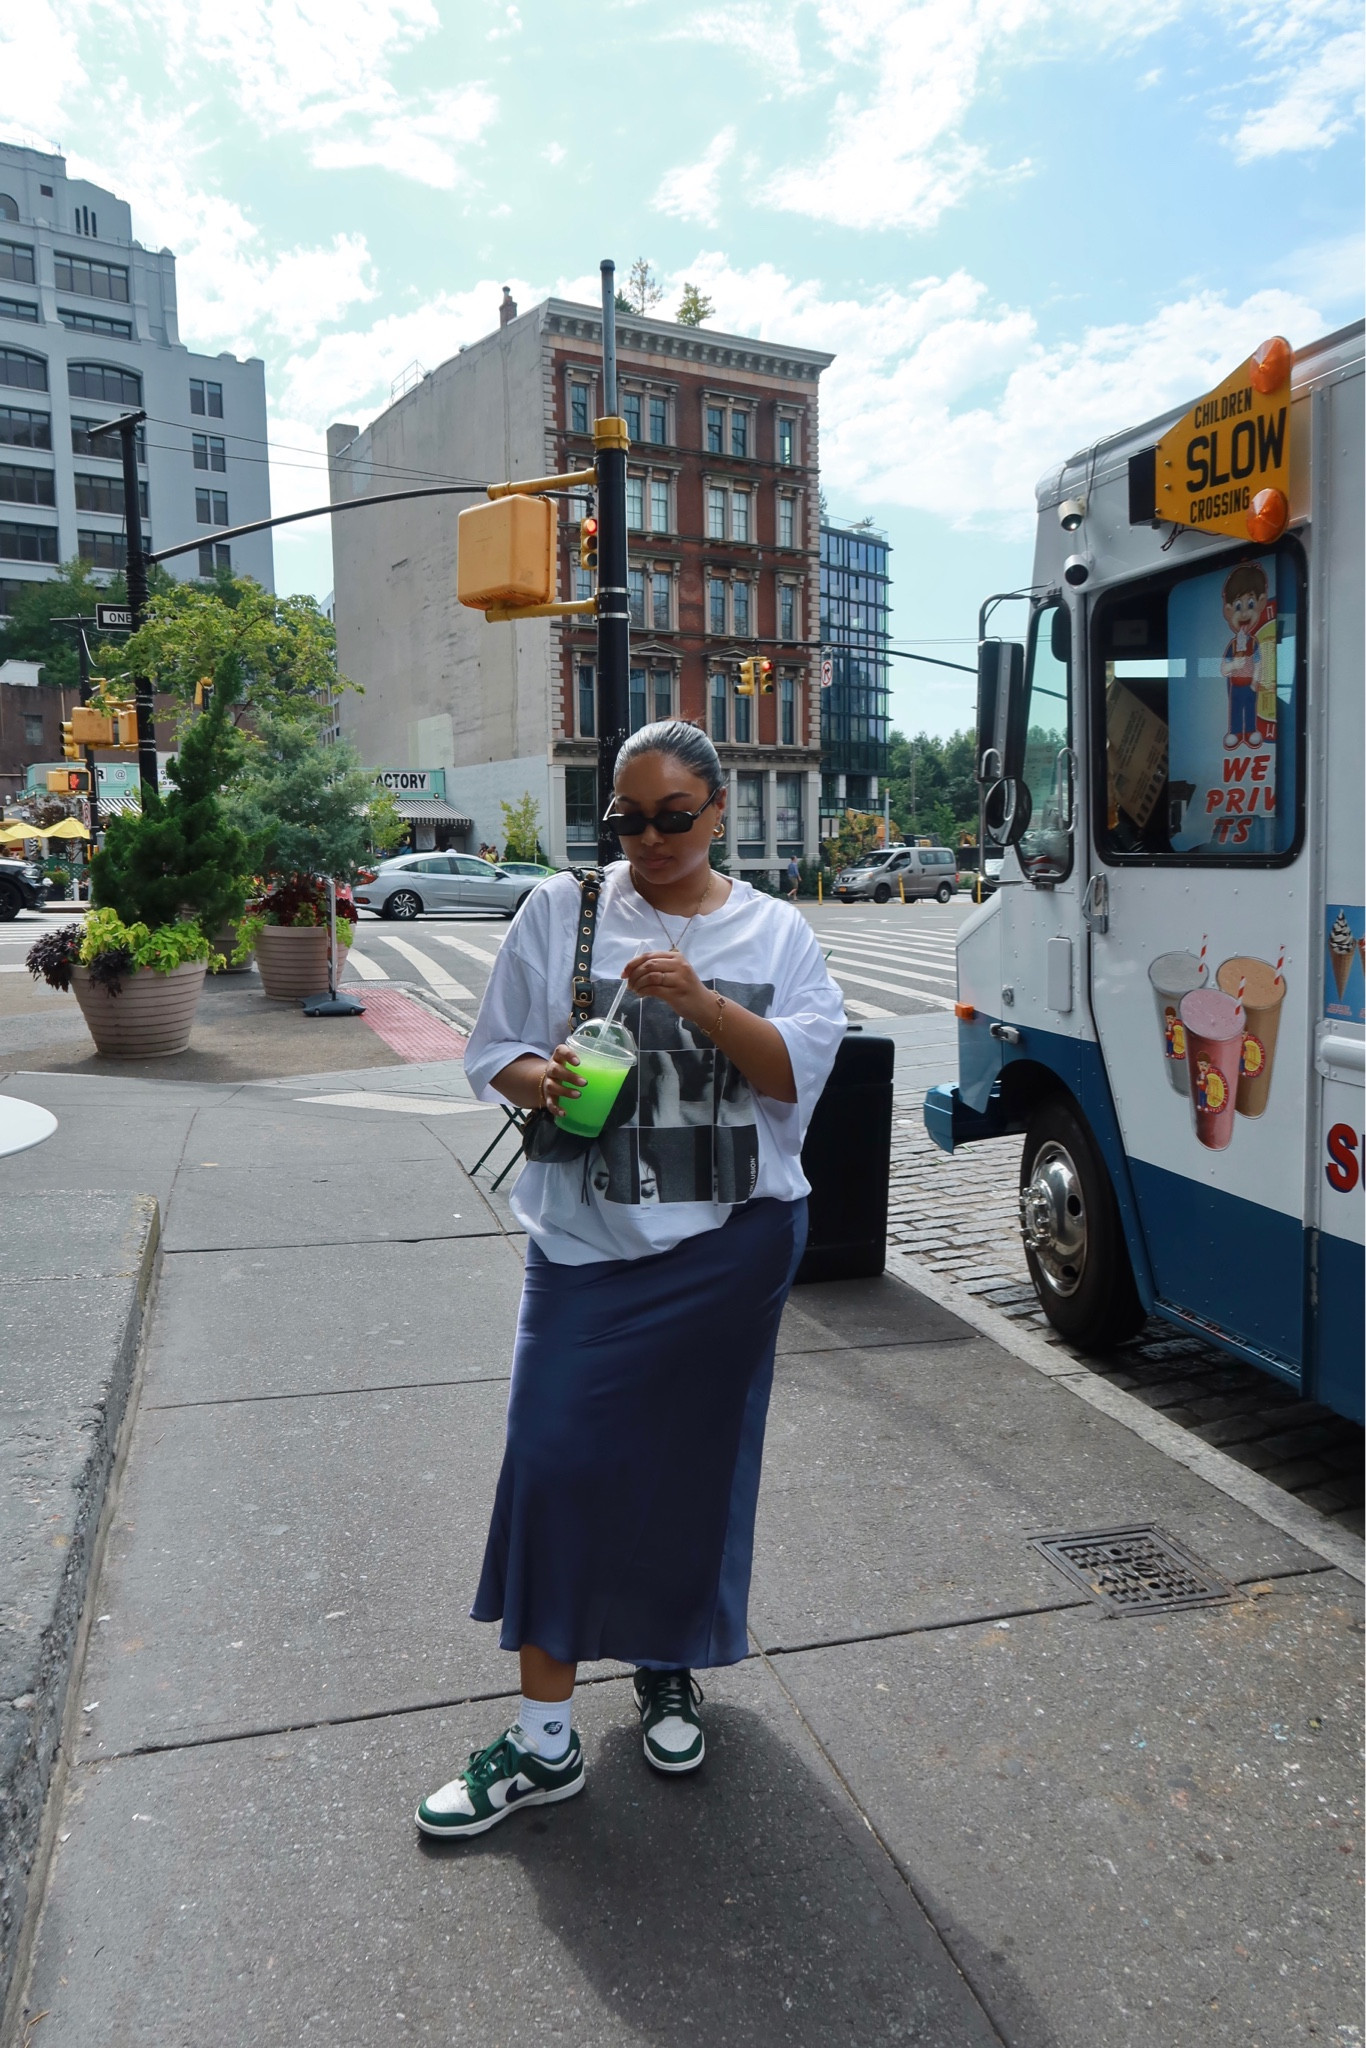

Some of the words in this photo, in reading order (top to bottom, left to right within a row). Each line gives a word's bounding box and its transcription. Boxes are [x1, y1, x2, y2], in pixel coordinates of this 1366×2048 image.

[1194, 387, 1253, 429] CHILDREN
[1186, 407, 1287, 493] SLOW
[1190, 486, 1250, 523] CROSSING
[109, 613, 132, 623] ONE
[1223, 755, 1271, 782] WE
